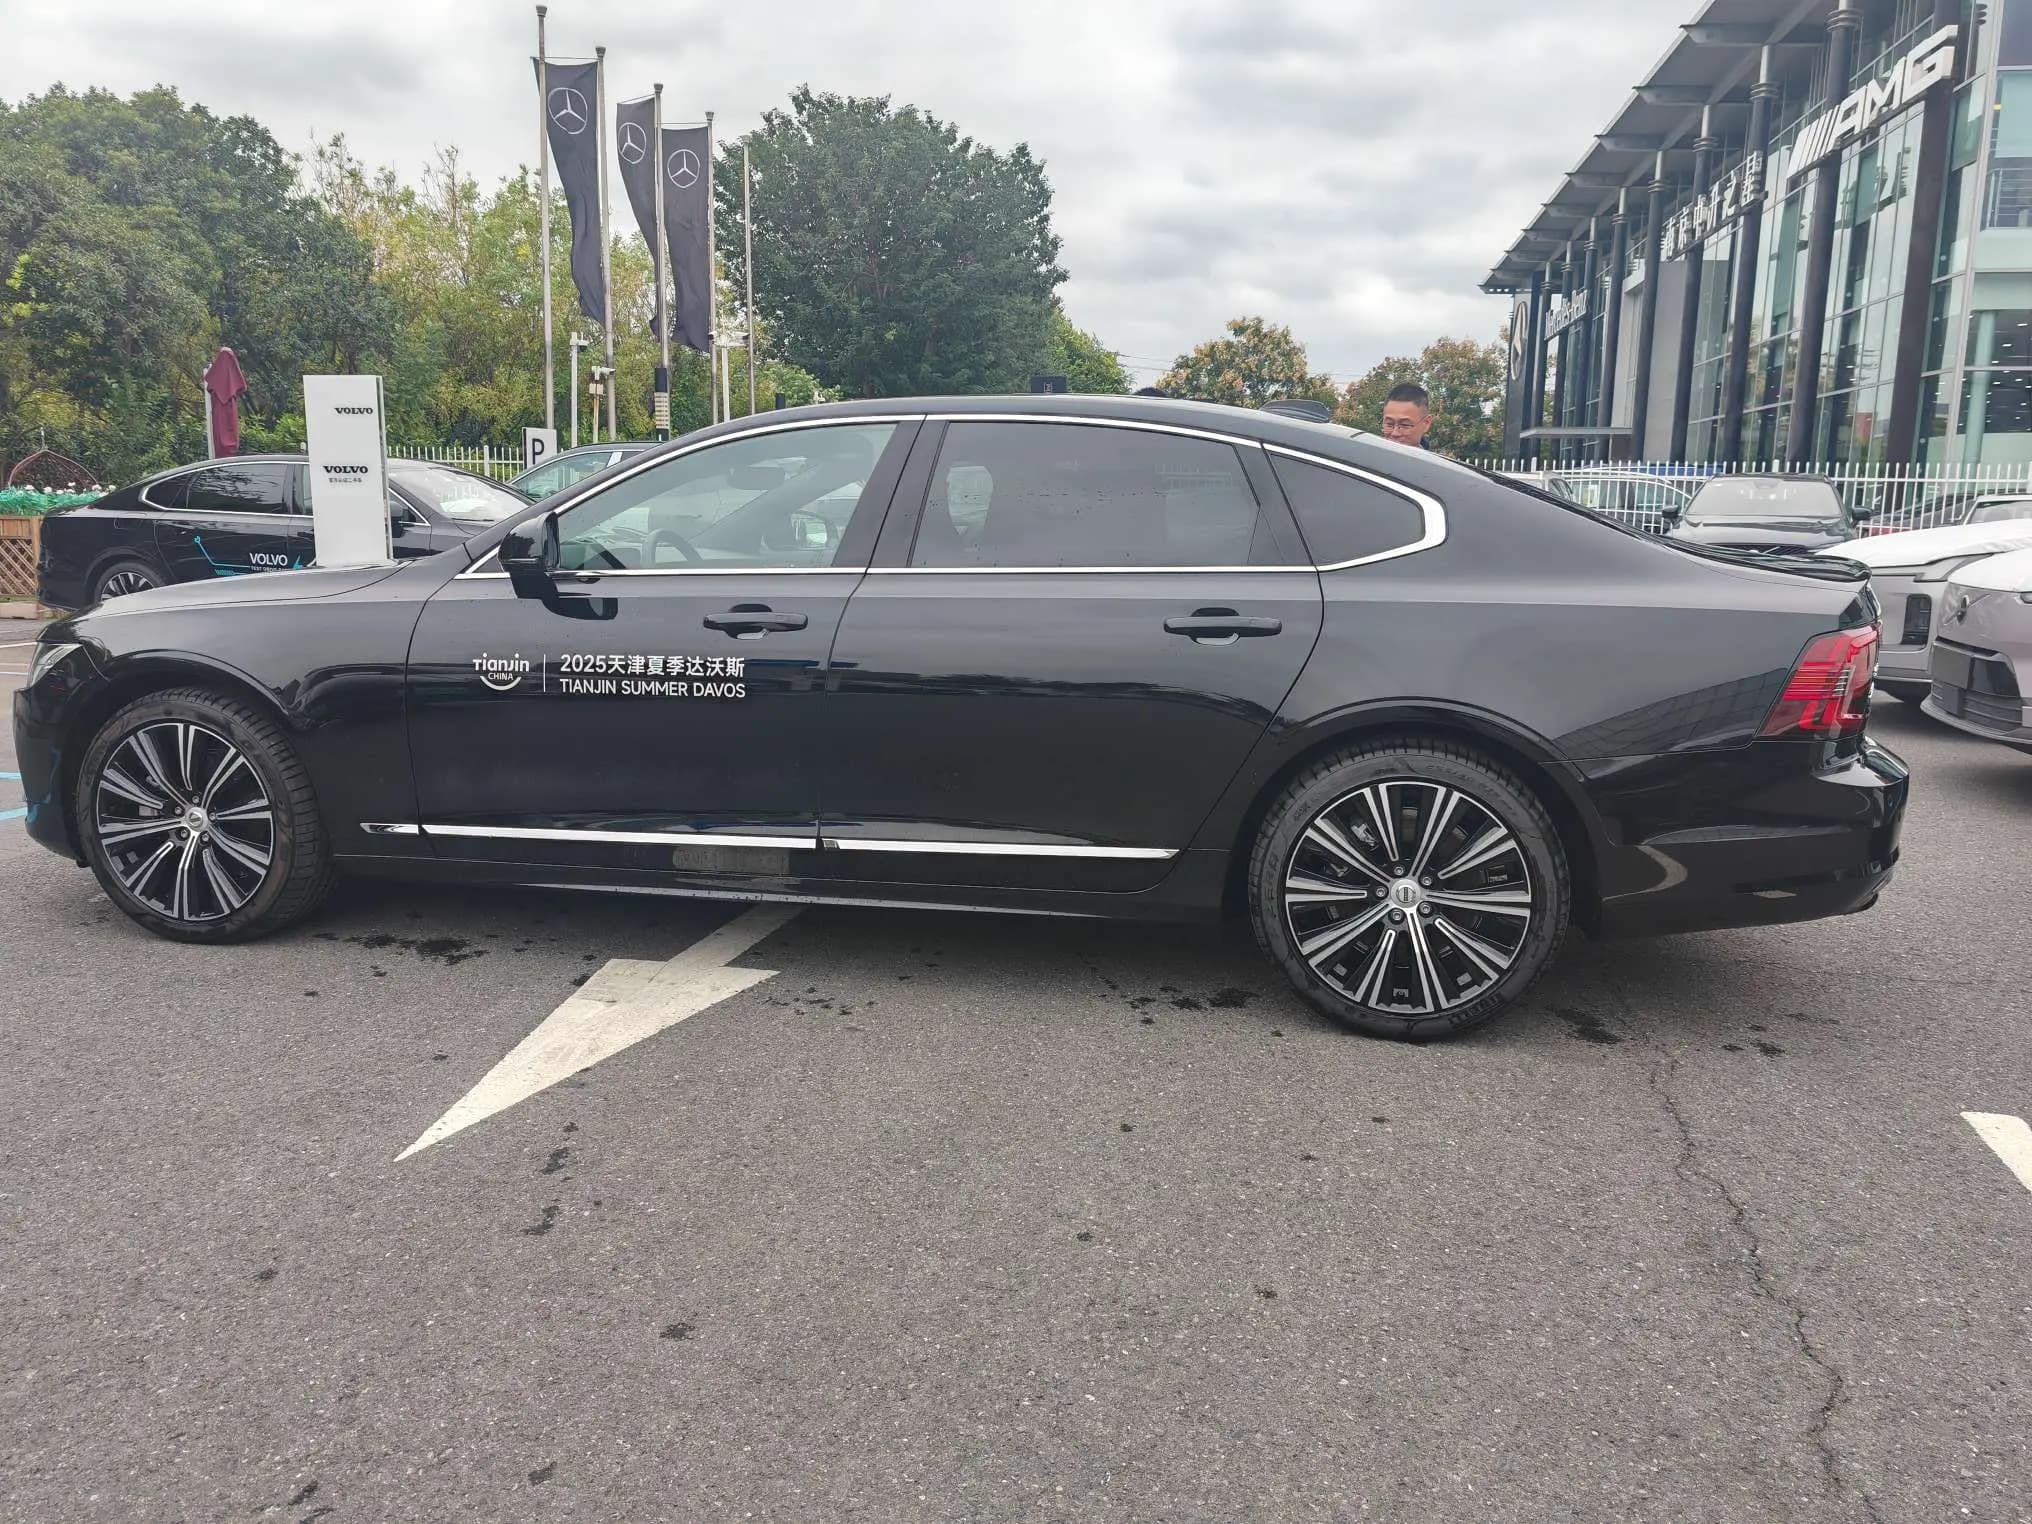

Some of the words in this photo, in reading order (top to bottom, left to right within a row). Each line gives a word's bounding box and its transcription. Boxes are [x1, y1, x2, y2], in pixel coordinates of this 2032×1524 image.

[1826, 24, 1959, 154] AMG
[334, 407, 374, 415] VOLVO
[532, 438, 545, 465] P
[323, 465, 369, 474] VOLVO
[249, 552, 288, 566] VOLVO
[560, 654, 745, 678] 2025天津夏季达沃斯
[488, 672, 514, 681] CHINA
[560, 679, 616, 694] TIANJIN
[621, 680, 688, 697] SUMMER
[693, 682, 746, 698] DAVOS
